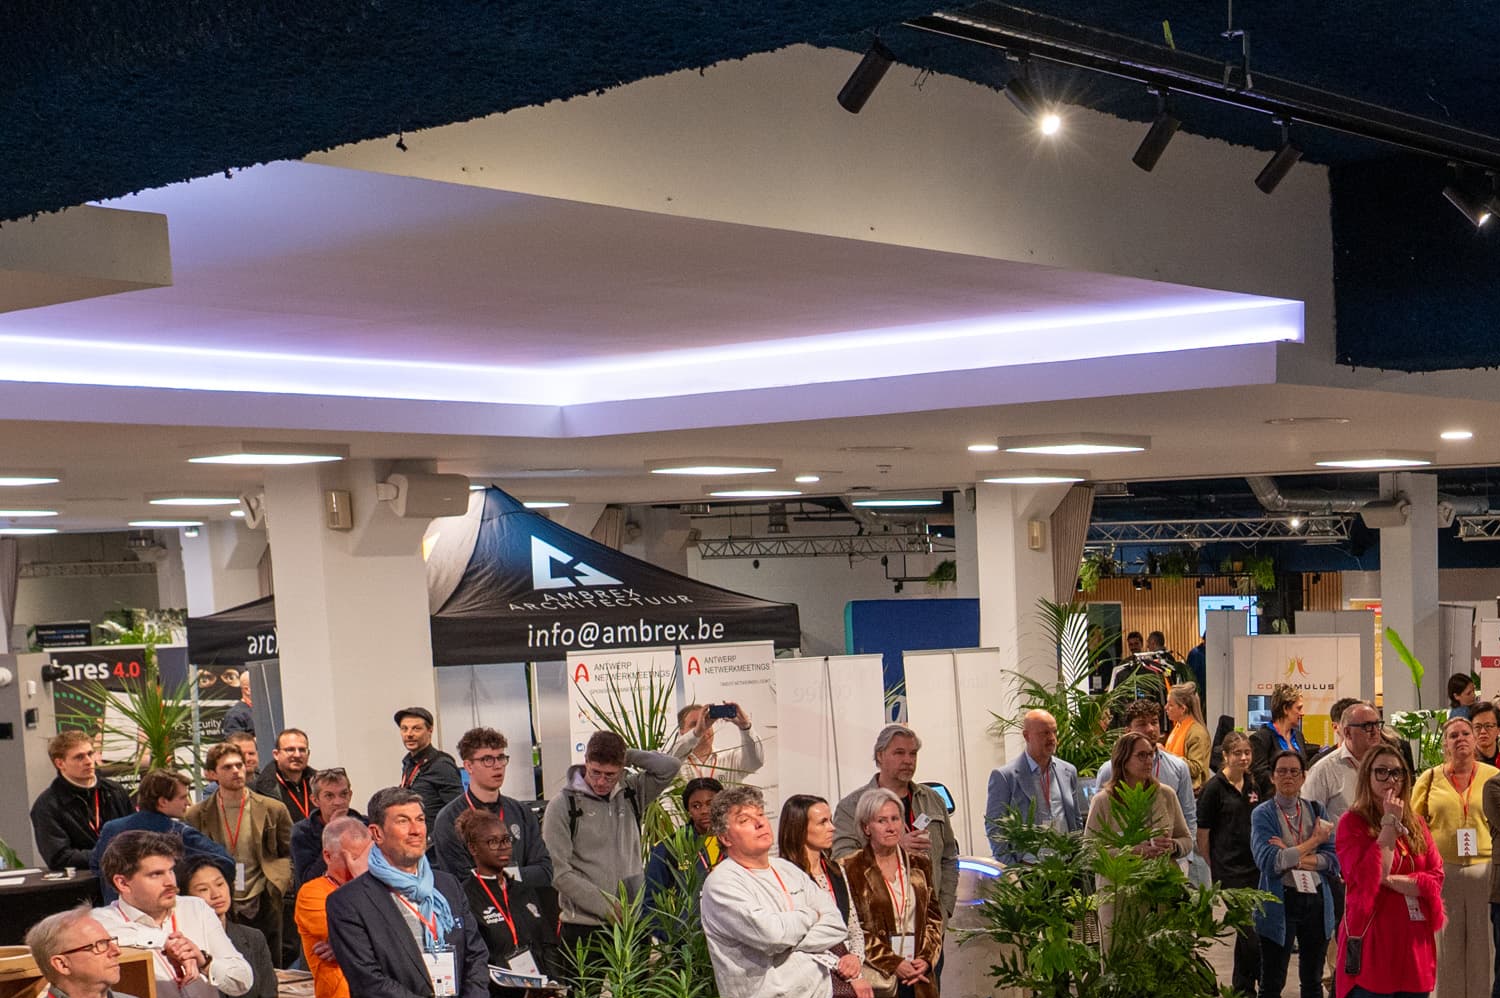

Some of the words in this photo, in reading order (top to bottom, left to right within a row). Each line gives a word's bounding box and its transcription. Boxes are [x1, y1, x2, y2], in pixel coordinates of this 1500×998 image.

[508, 594, 694, 612] ARCHITECTUUR
[543, 588, 641, 603] AMBREX
[527, 617, 725, 648] info@ambrex.be
[594, 661, 632, 671] ANTWERP
[704, 655, 737, 664] ANTWERP
[113, 661, 141, 678] 4.0
[704, 663, 770, 675] NETWERKMEETINGS
